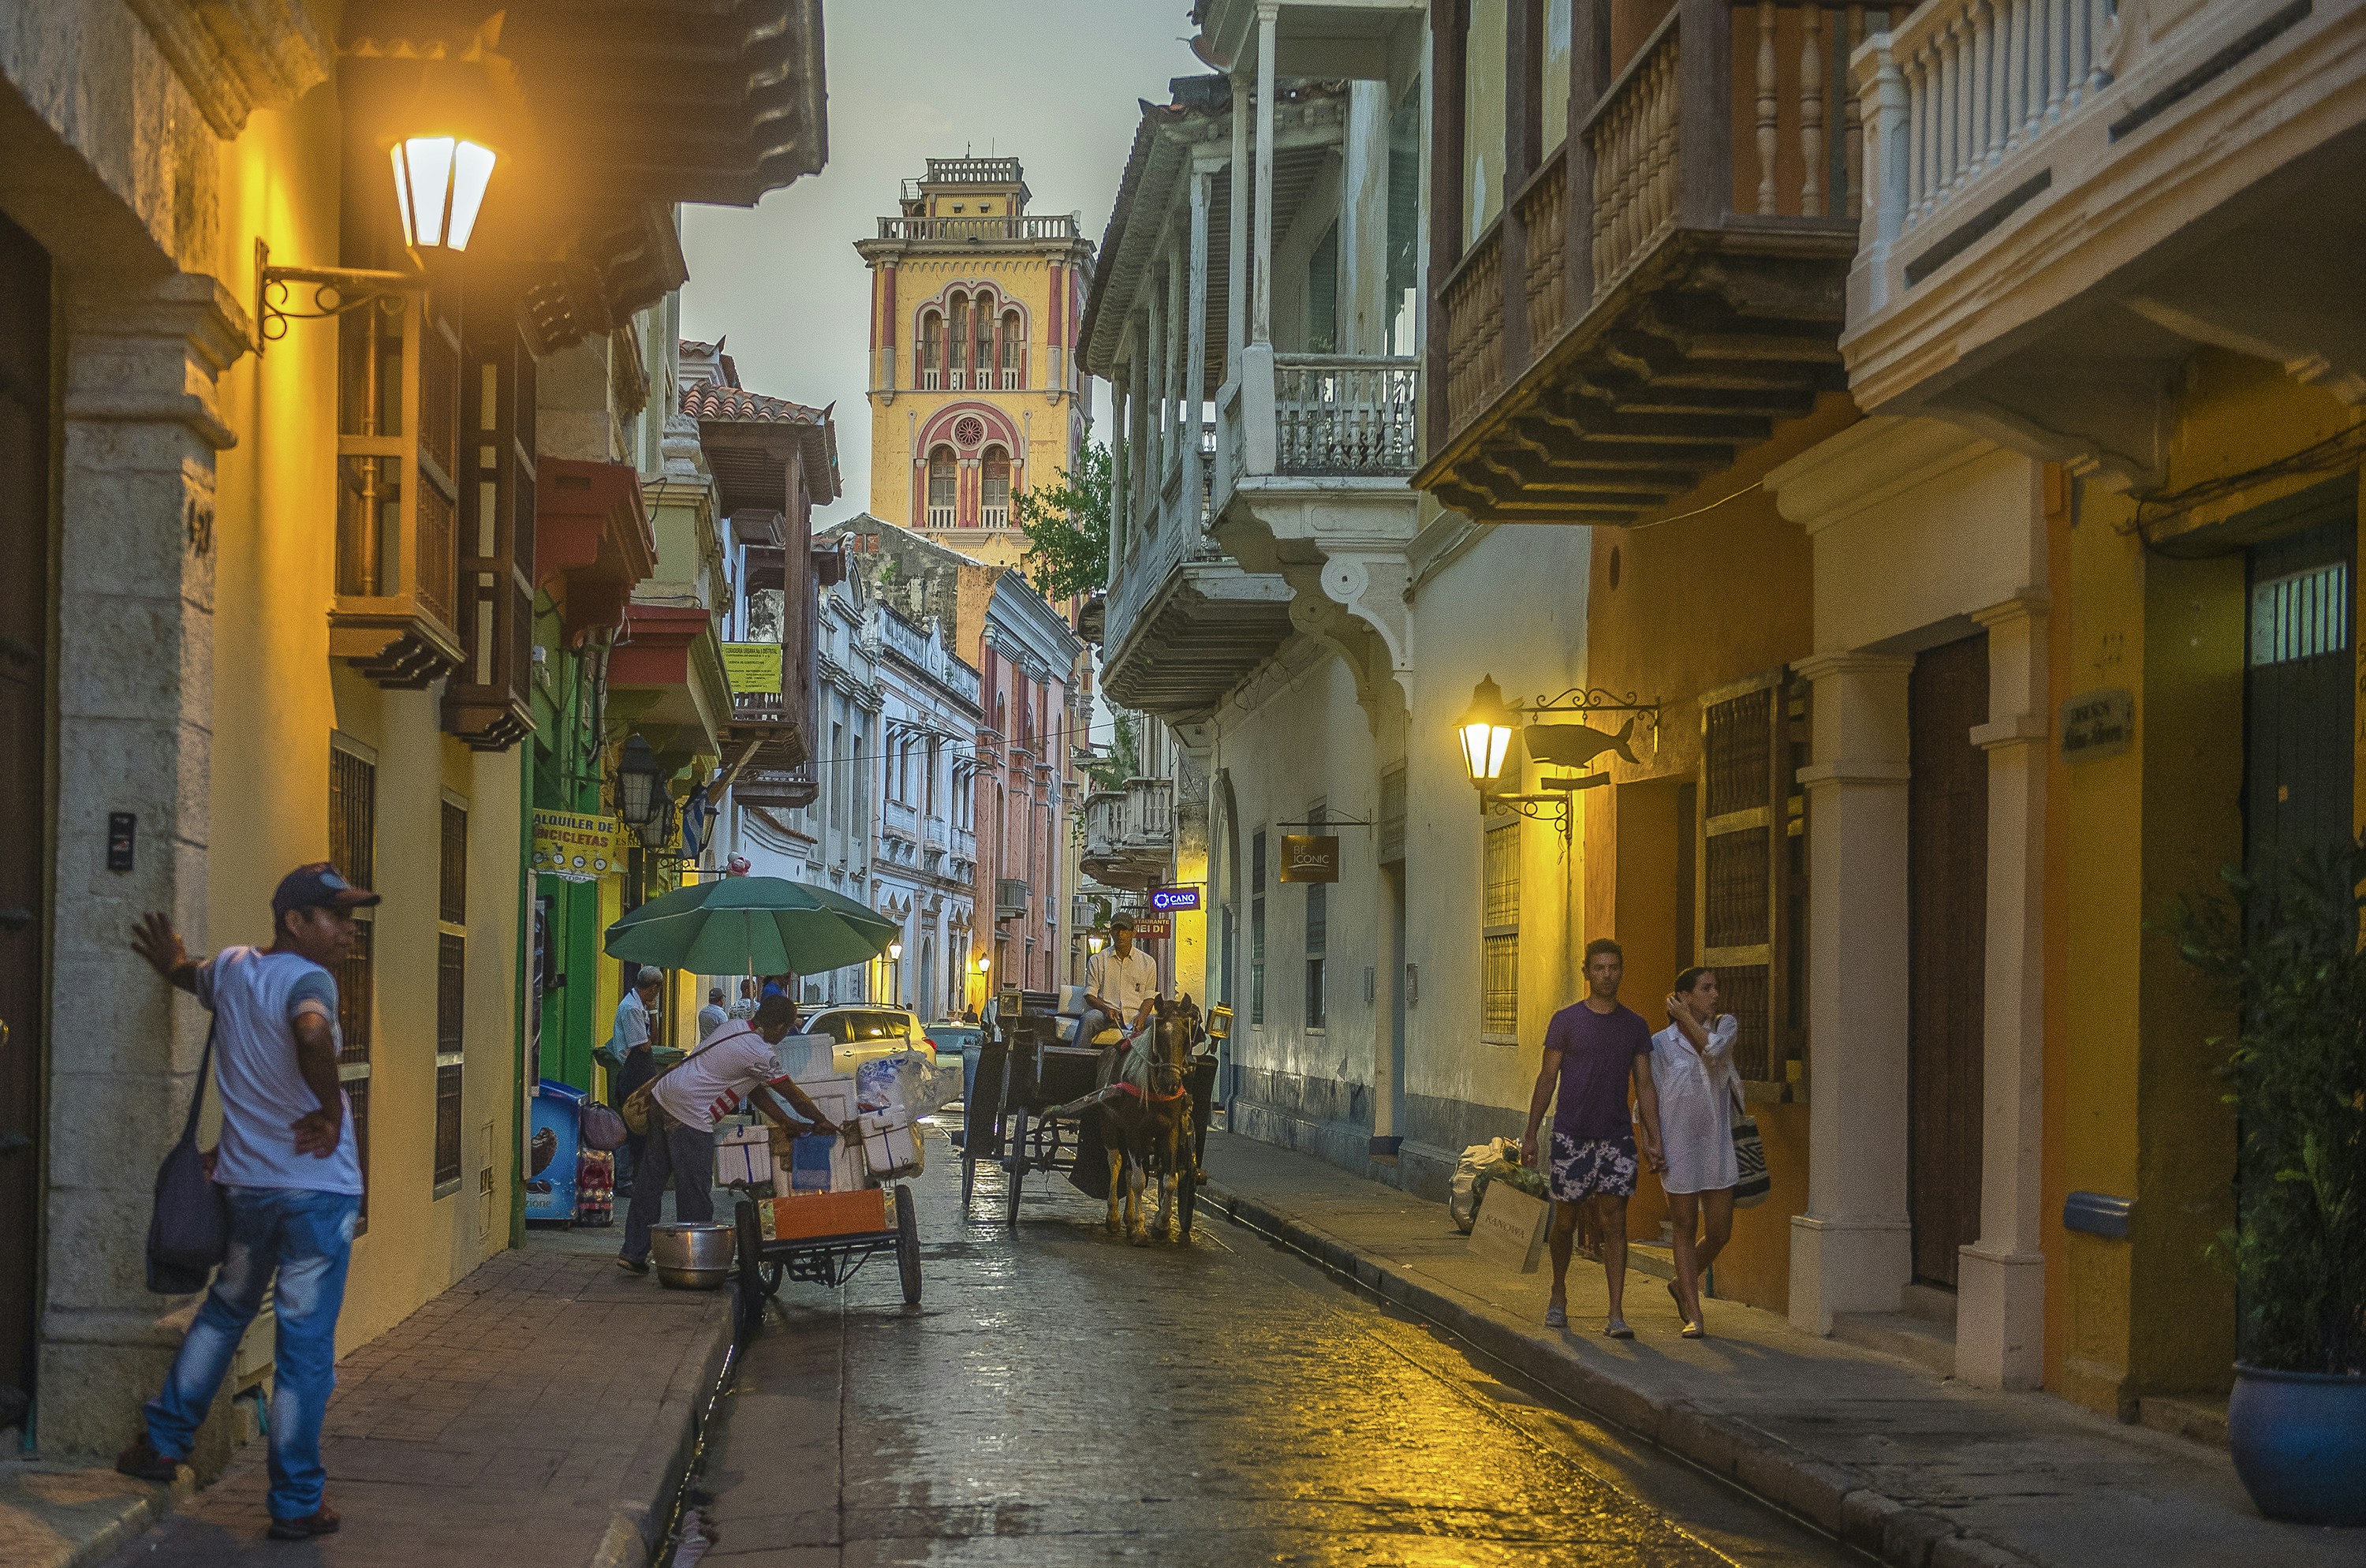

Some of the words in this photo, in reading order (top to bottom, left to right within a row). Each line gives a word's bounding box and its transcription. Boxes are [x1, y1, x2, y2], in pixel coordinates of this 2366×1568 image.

[534, 813, 594, 831] ALQUILER
[598, 821, 613, 833] DE
[1293, 846, 1307, 854] BE
[1293, 854, 1330, 864] ICONIC
[1170, 894, 1196, 903] CANO
